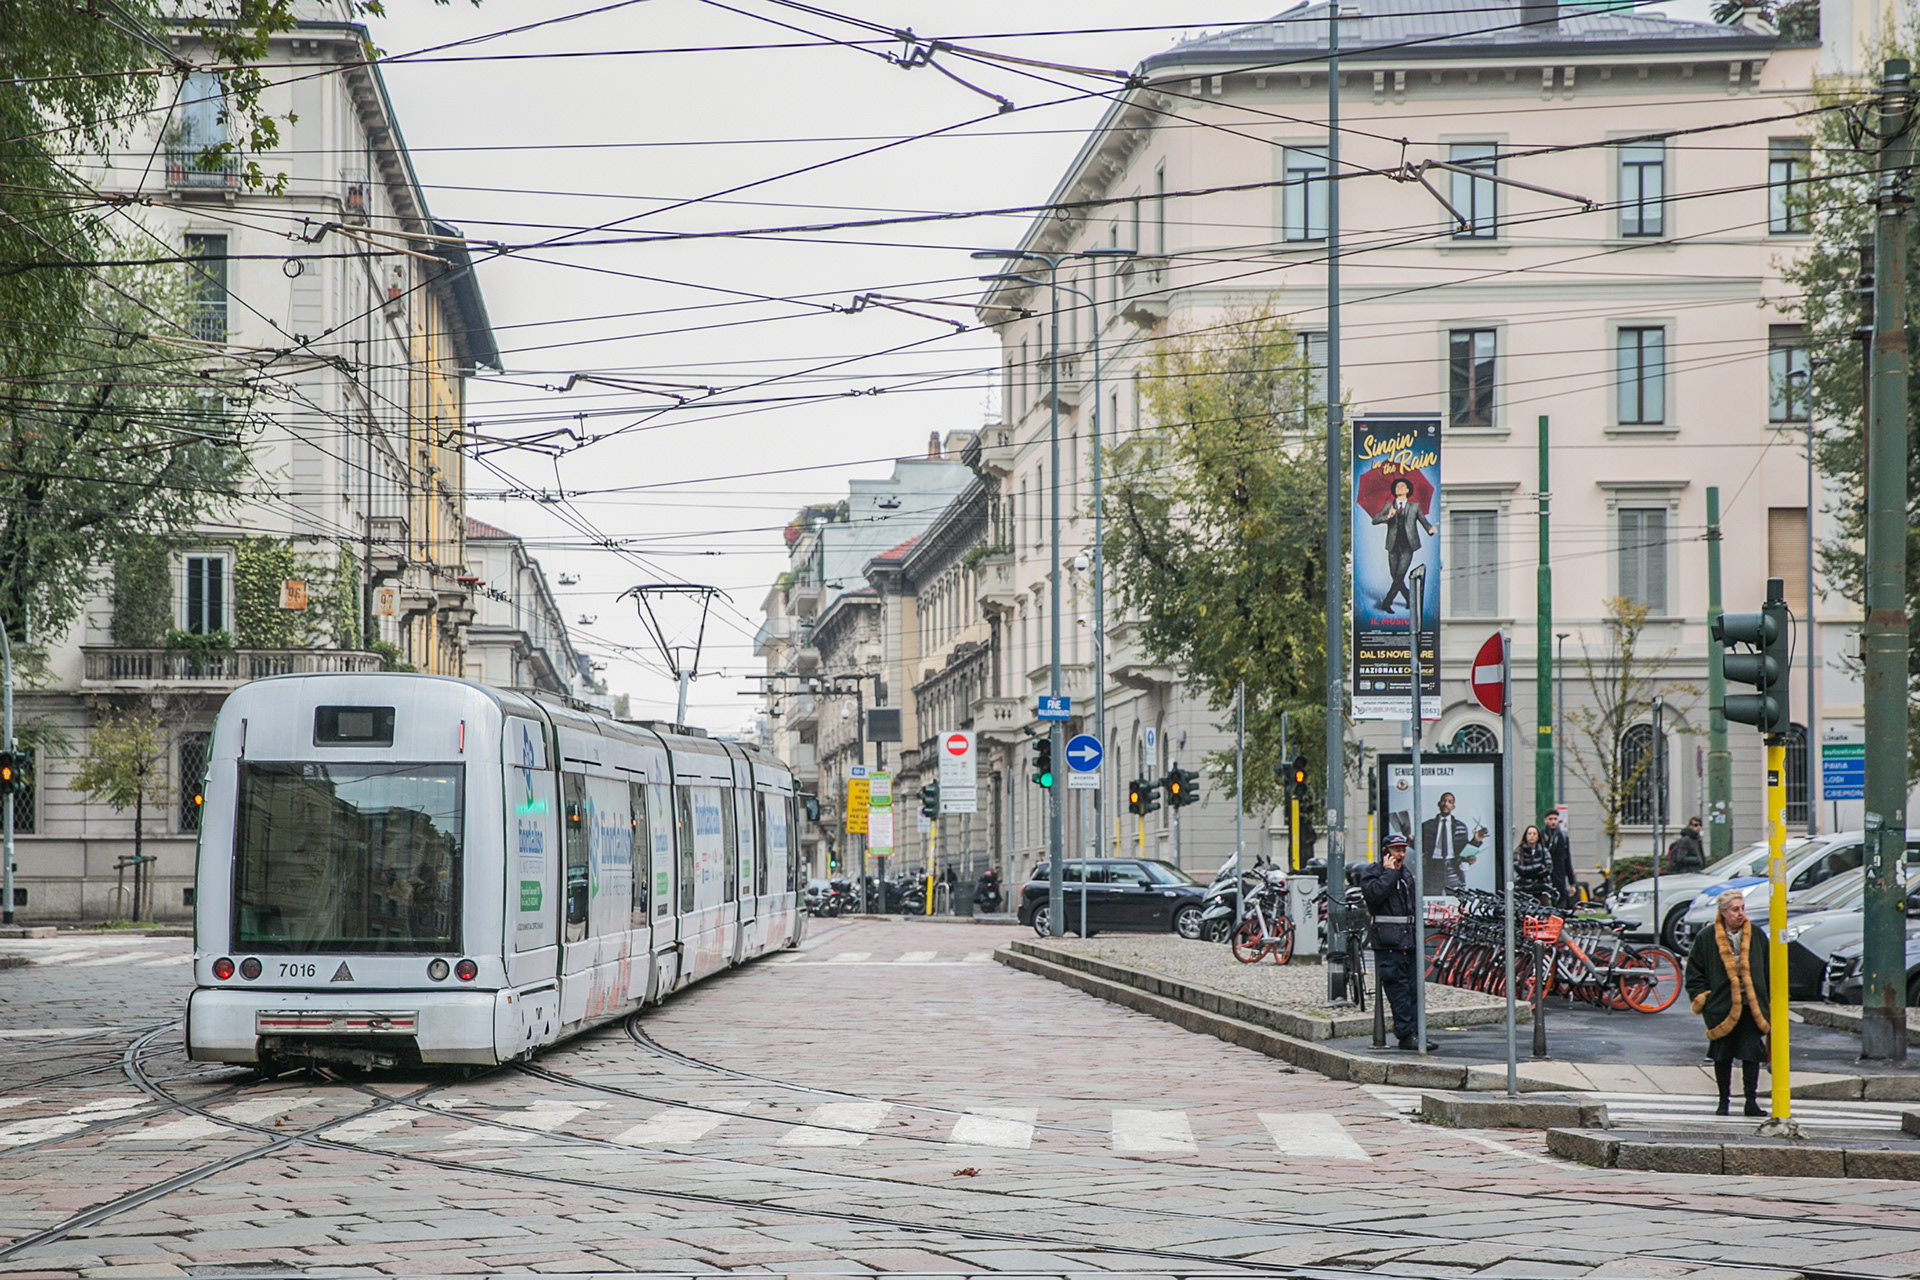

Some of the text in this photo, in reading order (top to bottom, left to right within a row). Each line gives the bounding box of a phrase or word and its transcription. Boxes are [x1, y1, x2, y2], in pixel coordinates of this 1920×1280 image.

[1358, 429, 1418, 462] Singin'
[1371, 449, 1438, 475] in the Rain
[1370, 617, 1411, 626] IL MUSIC
[1360, 650, 1434, 659] DAL 15 NOVERE
[1047, 699, 1062, 710] FINE
[1395, 767, 1454, 777] GENIUS BORN CRAZY
[1825, 776, 1844, 784] LODI
[1824, 789, 1864, 798] CREMON
[279, 963, 316, 978] 7016
